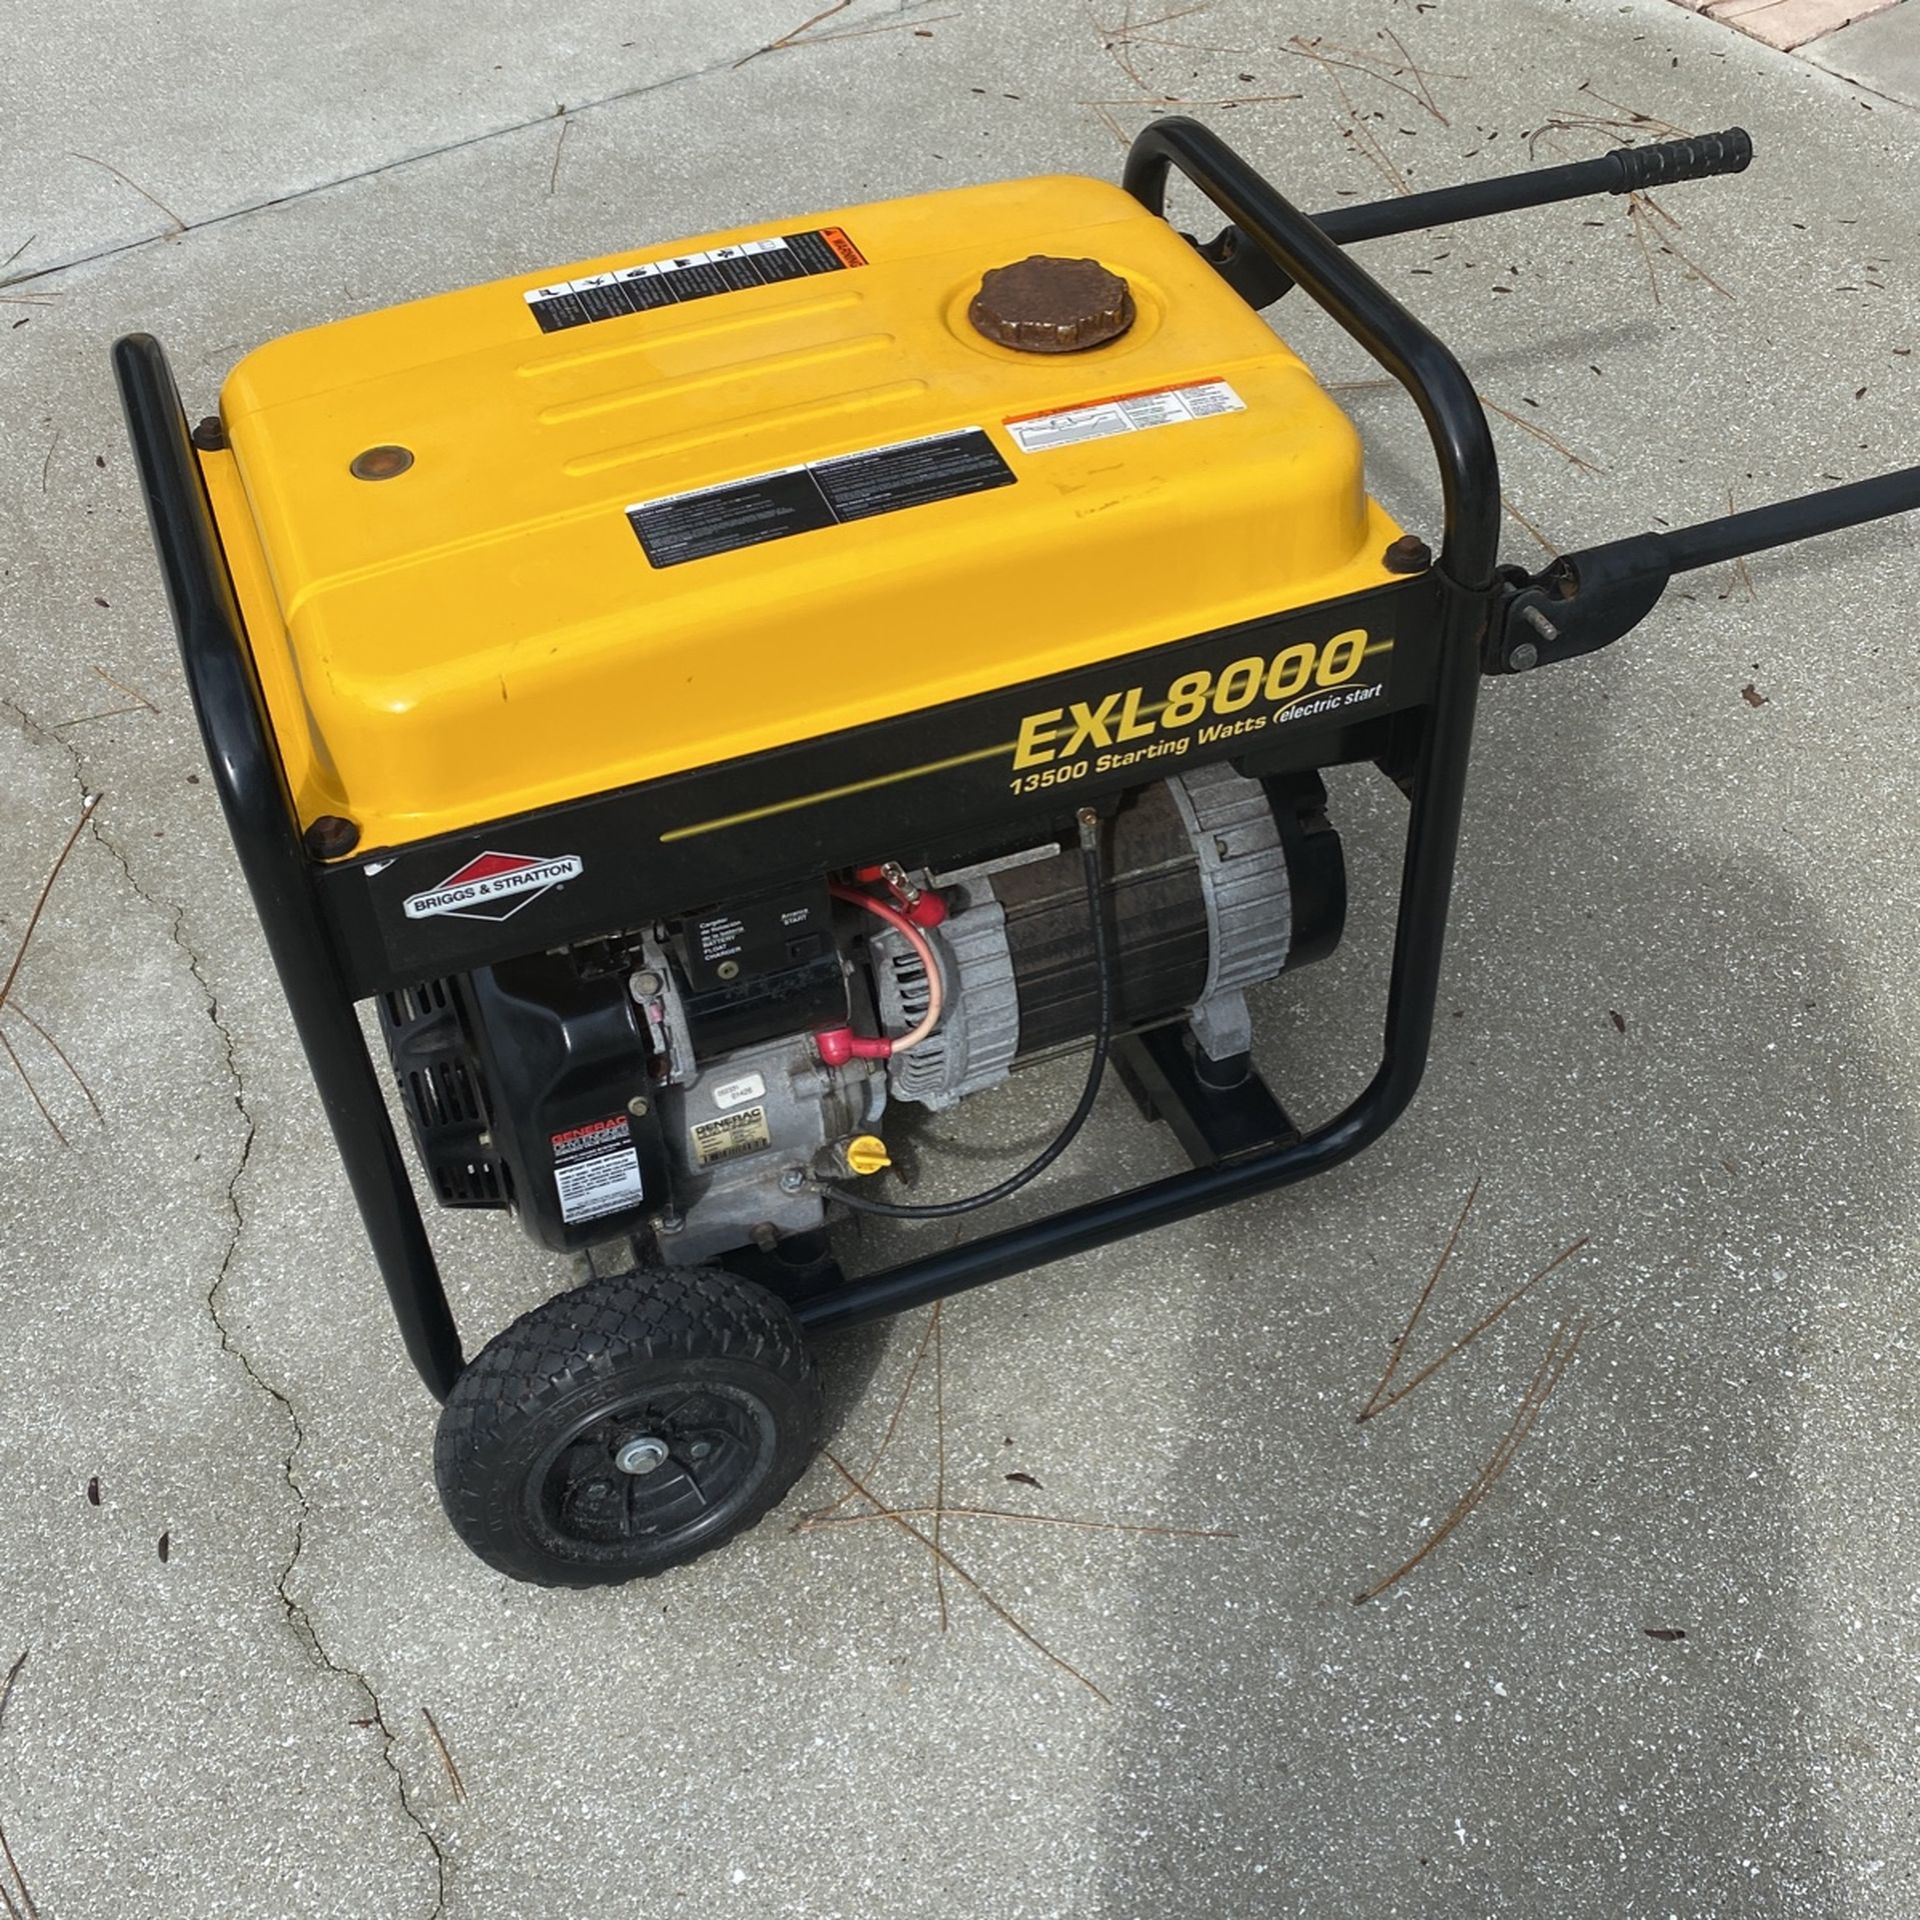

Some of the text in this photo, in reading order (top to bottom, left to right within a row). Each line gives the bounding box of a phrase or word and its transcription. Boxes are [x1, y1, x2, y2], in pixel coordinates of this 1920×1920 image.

[1012, 628, 1369, 771] EXL8000
[1279, 683, 1382, 724] electric start
[1008, 714, 1267, 796] 13500 Starting Watts
[414, 862, 573, 912] BRIGGS & STRATTON
[551, 1115, 627, 1143] GENERAC
[695, 1108, 761, 1135] GENERAC
